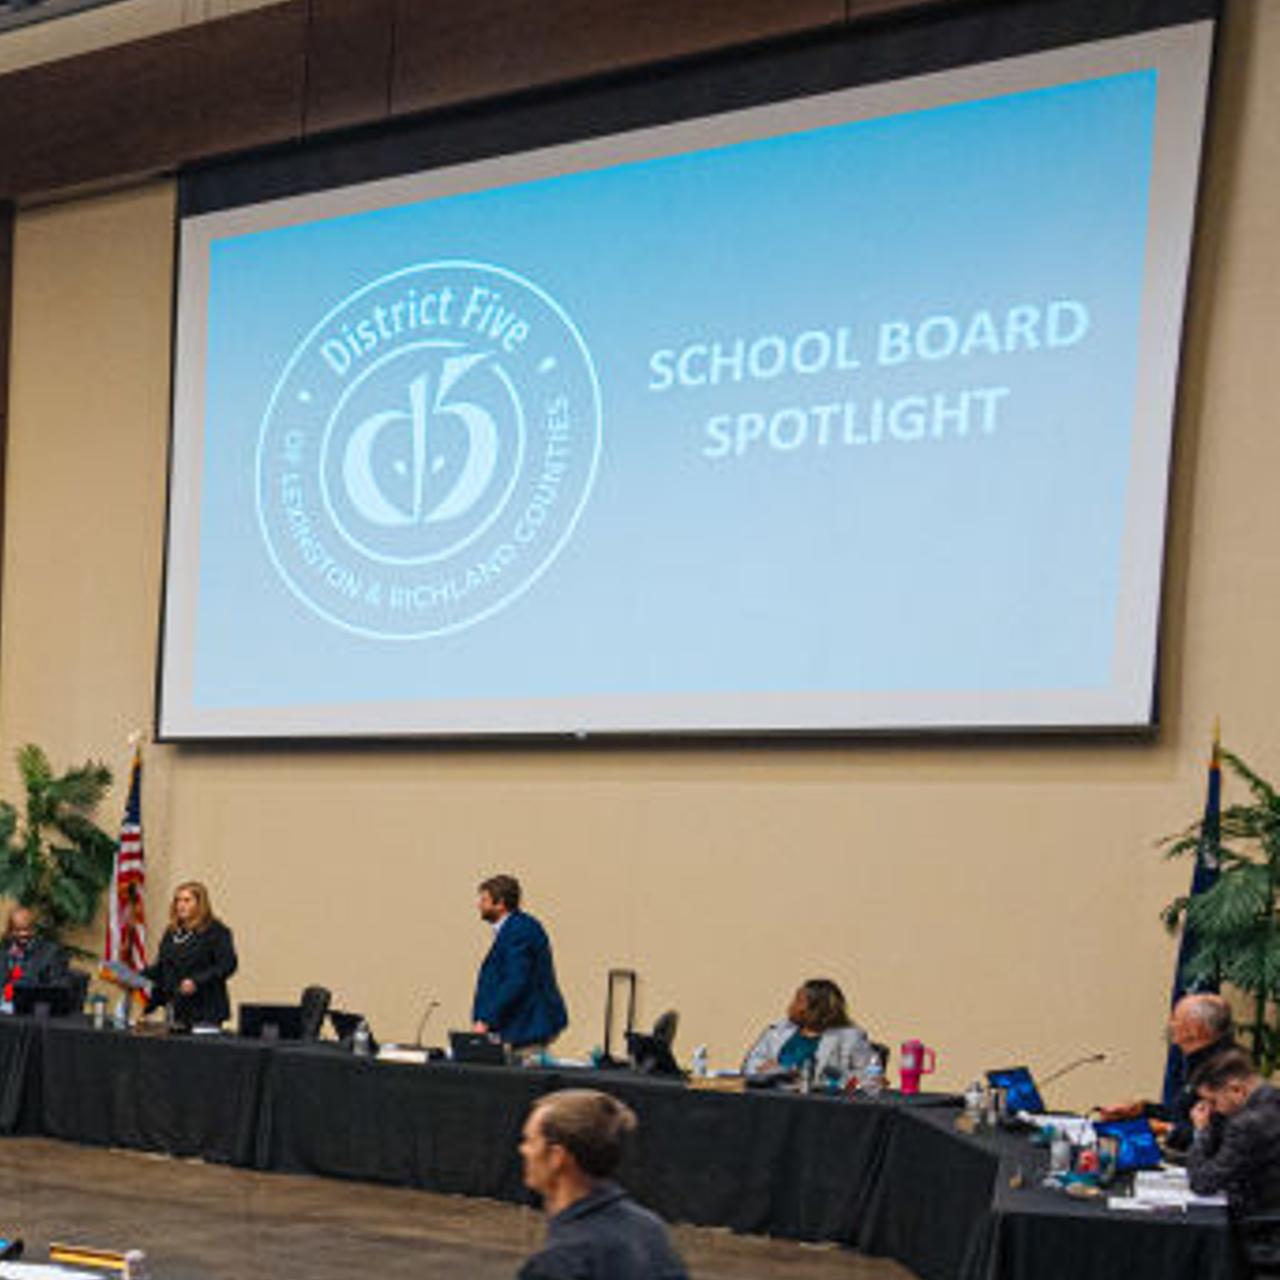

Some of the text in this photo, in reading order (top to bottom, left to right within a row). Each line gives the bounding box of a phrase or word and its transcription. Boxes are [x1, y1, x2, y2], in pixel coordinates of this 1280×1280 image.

[320, 285, 532, 376] District Five
[648, 299, 1090, 391] SCHOOL BOARD
[702, 386, 1011, 459] SPOTLIGHT
